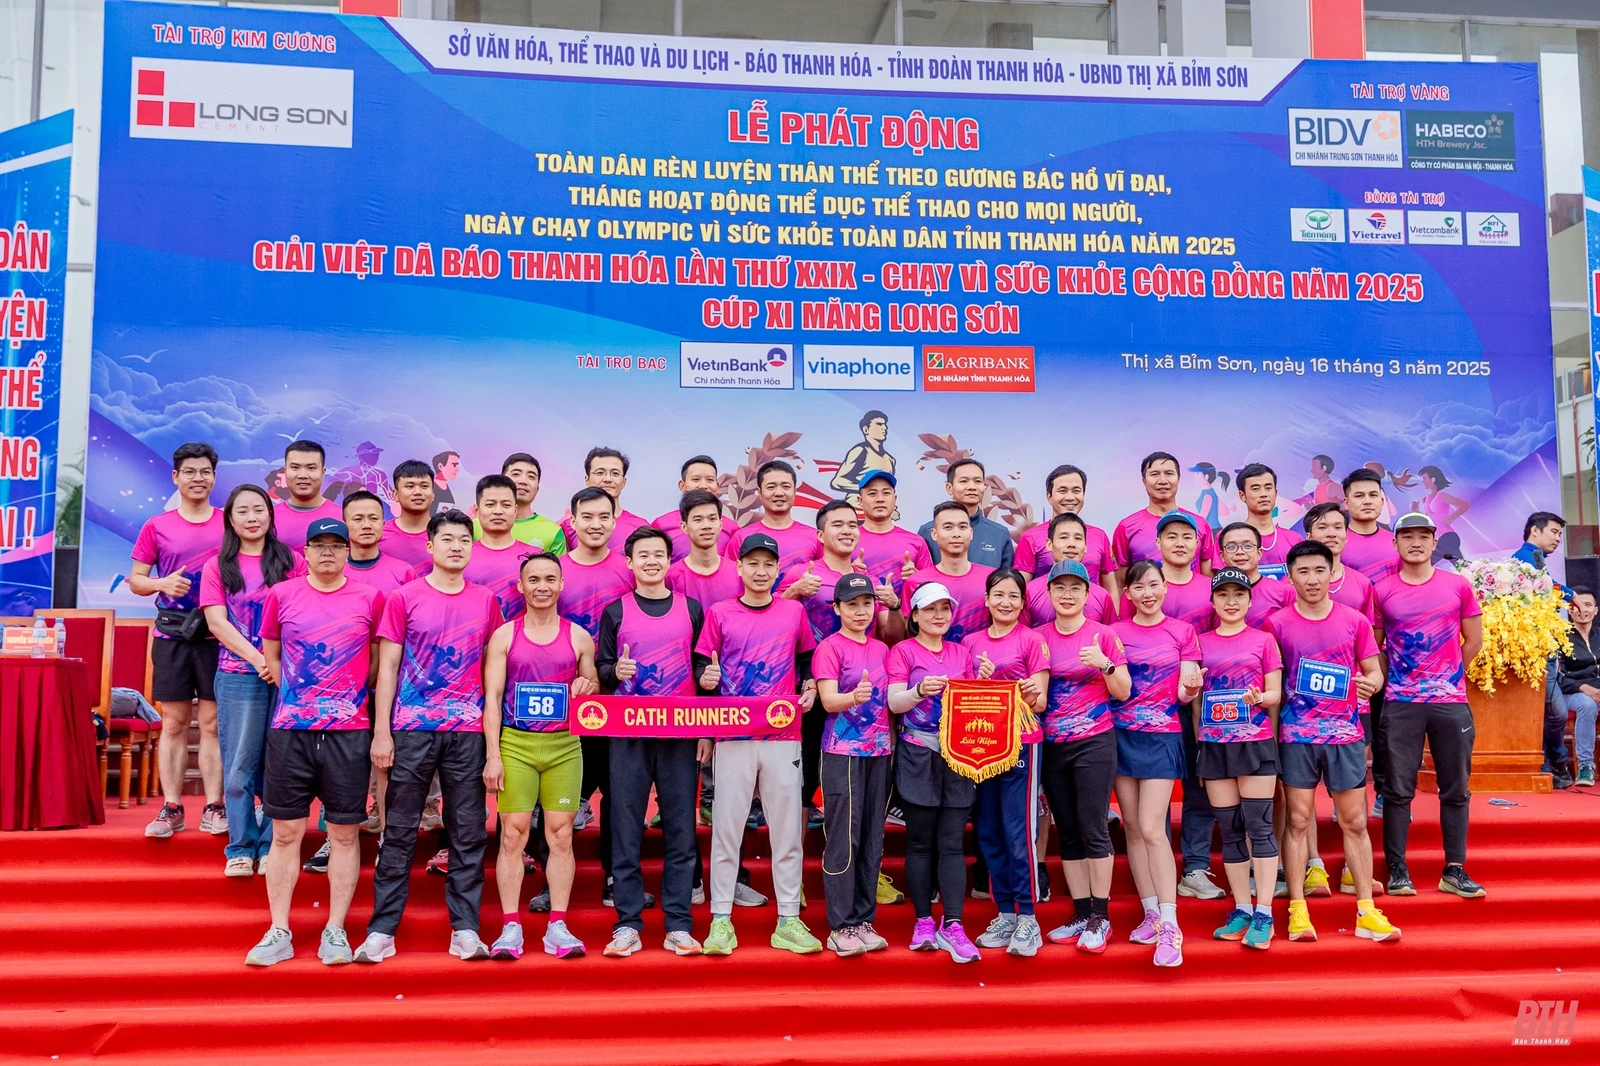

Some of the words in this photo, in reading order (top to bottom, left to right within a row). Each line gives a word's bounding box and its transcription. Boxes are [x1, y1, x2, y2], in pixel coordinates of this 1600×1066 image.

[153, 22, 182, 43] TÀI
[189, 26, 225, 49] TRỢ
[232, 29, 266, 49] KIM
[273, 31, 336, 53] CƯƠNG
[448, 28, 471, 56] SỞ
[476, 34, 510, 58] VĂN
[515, 36, 554, 65] HÓA,
[558, 35, 589, 65] THỂ
[594, 44, 635, 67] THAO
[640, 42, 662, 68] VÀ
[667, 48, 688, 69] DU
[693, 49, 729, 76] LỊCH
[745, 47, 778, 75] BÁO
[782, 52, 834, 77] THANH
[840, 51, 872, 78] HÓA
[887, 50, 924, 79] TỈNH
[929, 55, 972, 81] ĐOÀN
[976, 60, 1028, 83] THANH
[1033, 56, 1065, 84] HÓA
[1080, 63, 1122, 86] UBND
[1126, 63, 1151, 90] THỊ
[1156, 61, 1177, 87] XÃ
[1181, 58, 1211, 88] BỈM
[1216, 65, 1248, 89] SƠN
[1350, 81, 1374, 99] TÀI
[1378, 82, 1405, 102] TRỢ
[1410, 82, 1449, 101] VÀNG
[200, 102, 279, 122] LONG
[286, 107, 347, 126] SON
[199, 121, 279, 132] CEMENT
[727, 99, 770, 144] LỄ
[780, 106, 873, 147] PHÁT
[881, 109, 980, 156] ĐỘNG
[1295, 117, 1372, 146] BIDV
[1415, 123, 1487, 138] HABECO
[1437, 140, 1470, 150] Brewery
[1472, 141, 1487, 149] Jsc.
[1295, 152, 1305, 160] CHI
[1307, 151, 1328, 160] NHÁNH
[1330, 152, 1349, 161] TRUNG
[1351, 152, 1363, 161] SƠN
[1364, 153, 1384, 162] THANH
[1386, 152, 1399, 162] HÓA
[536, 151, 594, 174] TOÀN
[601, 153, 646, 177] DÂN
[653, 155, 697, 179] RÈN
[704, 158, 772, 185] LUYỆN
[778, 160, 835, 184] THÂN
[841, 159, 880, 186] THỂ
[886, 168, 937, 187] THEO
[944, 169, 1016, 189] GƯƠNG
[1022, 167, 1065, 191] BÁC
[1070, 166, 1099, 191] HỒ
[1104, 168, 1125, 192] VĨ
[1130, 173, 1172, 197] ĐẠI,
[569, 184, 642, 208] THÁNG
[649, 190, 704, 214] HOẠT
[711, 189, 771, 216] ĐỘNG
[777, 188, 817, 214] THỂ
[823, 194, 866, 220] DỤC
[872, 191, 911, 217] THỂ
[917, 199, 970, 219] THAO
[976, 200, 1019, 220] CHO
[1026, 201, 1066, 225] MỌI
[1072, 199, 1143, 225] NGƯỜI,
[1364, 188, 1397, 204] ĐỒNG
[1400, 191, 1419, 204] TÀI
[1422, 192, 1445, 207] TRỢ
[464, 211, 525, 236] NGÀY
[532, 216, 591, 241] CHẠY
[597, 219, 693, 242] OLYMPIC
[700, 218, 721, 243] VÌ
[727, 220, 771, 245] SỨC
[778, 220, 834, 247] KHỎE
[841, 225, 897, 249] TOÀN
[903, 226, 947, 250] DÂN
[953, 226, 1001, 251] TỈNH
[1008, 232, 1077, 253] THANH
[1083, 229, 1125, 253] HÓA
[1131, 231, 1180, 255] NĂM
[1186, 236, 1236, 257] 2025
[1352, 230, 1402, 240] Vietravel
[1410, 226, 1460, 235] Vietcombank
[253, 235, 314, 272] GIẢI
[322, 240, 387, 279] VIỆT
[394, 243, 434, 277] DÃ
[442, 244, 501, 279] BÁO
[509, 250, 603, 283] THANH
[610, 249, 667, 285] HÓA
[675, 248, 725, 287] LẦN
[733, 256, 791, 289] THỨ
[795, 259, 857, 291] XXIX
[881, 261, 953, 297] CHẠY
[959, 259, 987, 293] VÌ
[995, 260, 1050, 293] SỨC
[1057, 260, 1126, 296] KHỎE
[1132, 264, 1205, 301] CỘNG
[1212, 261, 1284, 299] ĐỒNG
[1291, 267, 1349, 300] NĂM
[1355, 272, 1424, 302] 2025
[701, 296, 758, 329] CÚP
[765, 301, 794, 330] XI
[800, 297, 880, 331] MĂNG
[887, 303, 959, 333] LONG
[964, 302, 1020, 334] SƠN
[576, 353, 599, 369] TÀI
[604, 355, 632, 373] TRỢ
[638, 357, 667, 373] BẠC
[687, 357, 768, 372] VietinBank
[808, 357, 911, 377] vinaphone
[945, 357, 1030, 370] AGRIBANK
[1121, 353, 1149, 373] Thị
[1154, 355, 1174, 369] xã
[1179, 353, 1212, 370] Bỉm
[1217, 355, 1257, 374] Sơn,
[1262, 355, 1305, 376] ngày
[1310, 358, 1328, 373] 16
[1334, 357, 1384, 377] tháng
[1388, 359, 1400, 374] 3
[1405, 360, 1442, 376] năm
[1447, 360, 1491, 376] 2025
[694, 376, 708, 384] Chi
[710, 376, 735, 385] nhánh
[738, 377, 762, 385] Thanh
[764, 377, 780, 385] Hóa
[943, 374, 969, 382] NHÁNH
[988, 375, 1012, 383] THANH
[1014, 374, 1030, 383] HÓA
[1212, 570, 1249, 586] SPORT
[1309, 672, 1336, 693] 60
[528, 696, 554, 716] 58
[1211, 702, 1238, 722] 85
[624, 707, 667, 727] CATH
[674, 707, 750, 727] RUNNERS
